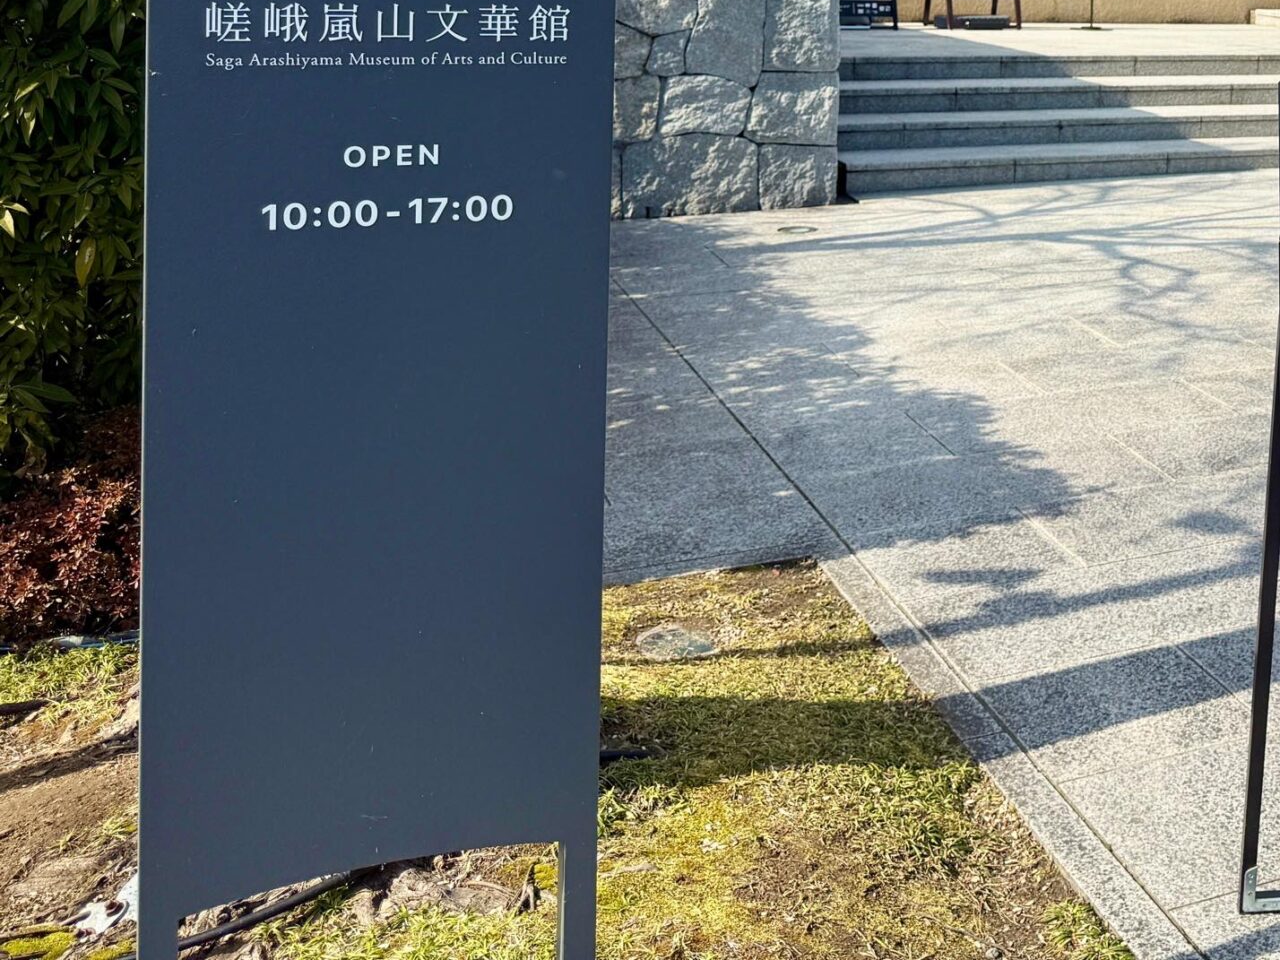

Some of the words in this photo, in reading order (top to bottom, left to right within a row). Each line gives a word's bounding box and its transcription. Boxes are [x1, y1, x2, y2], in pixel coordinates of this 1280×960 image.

[205, 1, 571, 43] 嵯峨嵐山文華館
[206, 52, 243, 71] Saga
[249, 52, 343, 70] Arashiyama
[349, 52, 415, 66] Museum
[421, 52, 439, 66] of
[442, 52, 473, 66] Arts
[478, 51, 505, 66] and
[510, 51, 567, 66] Culture
[343, 143, 440, 168] OPEN
